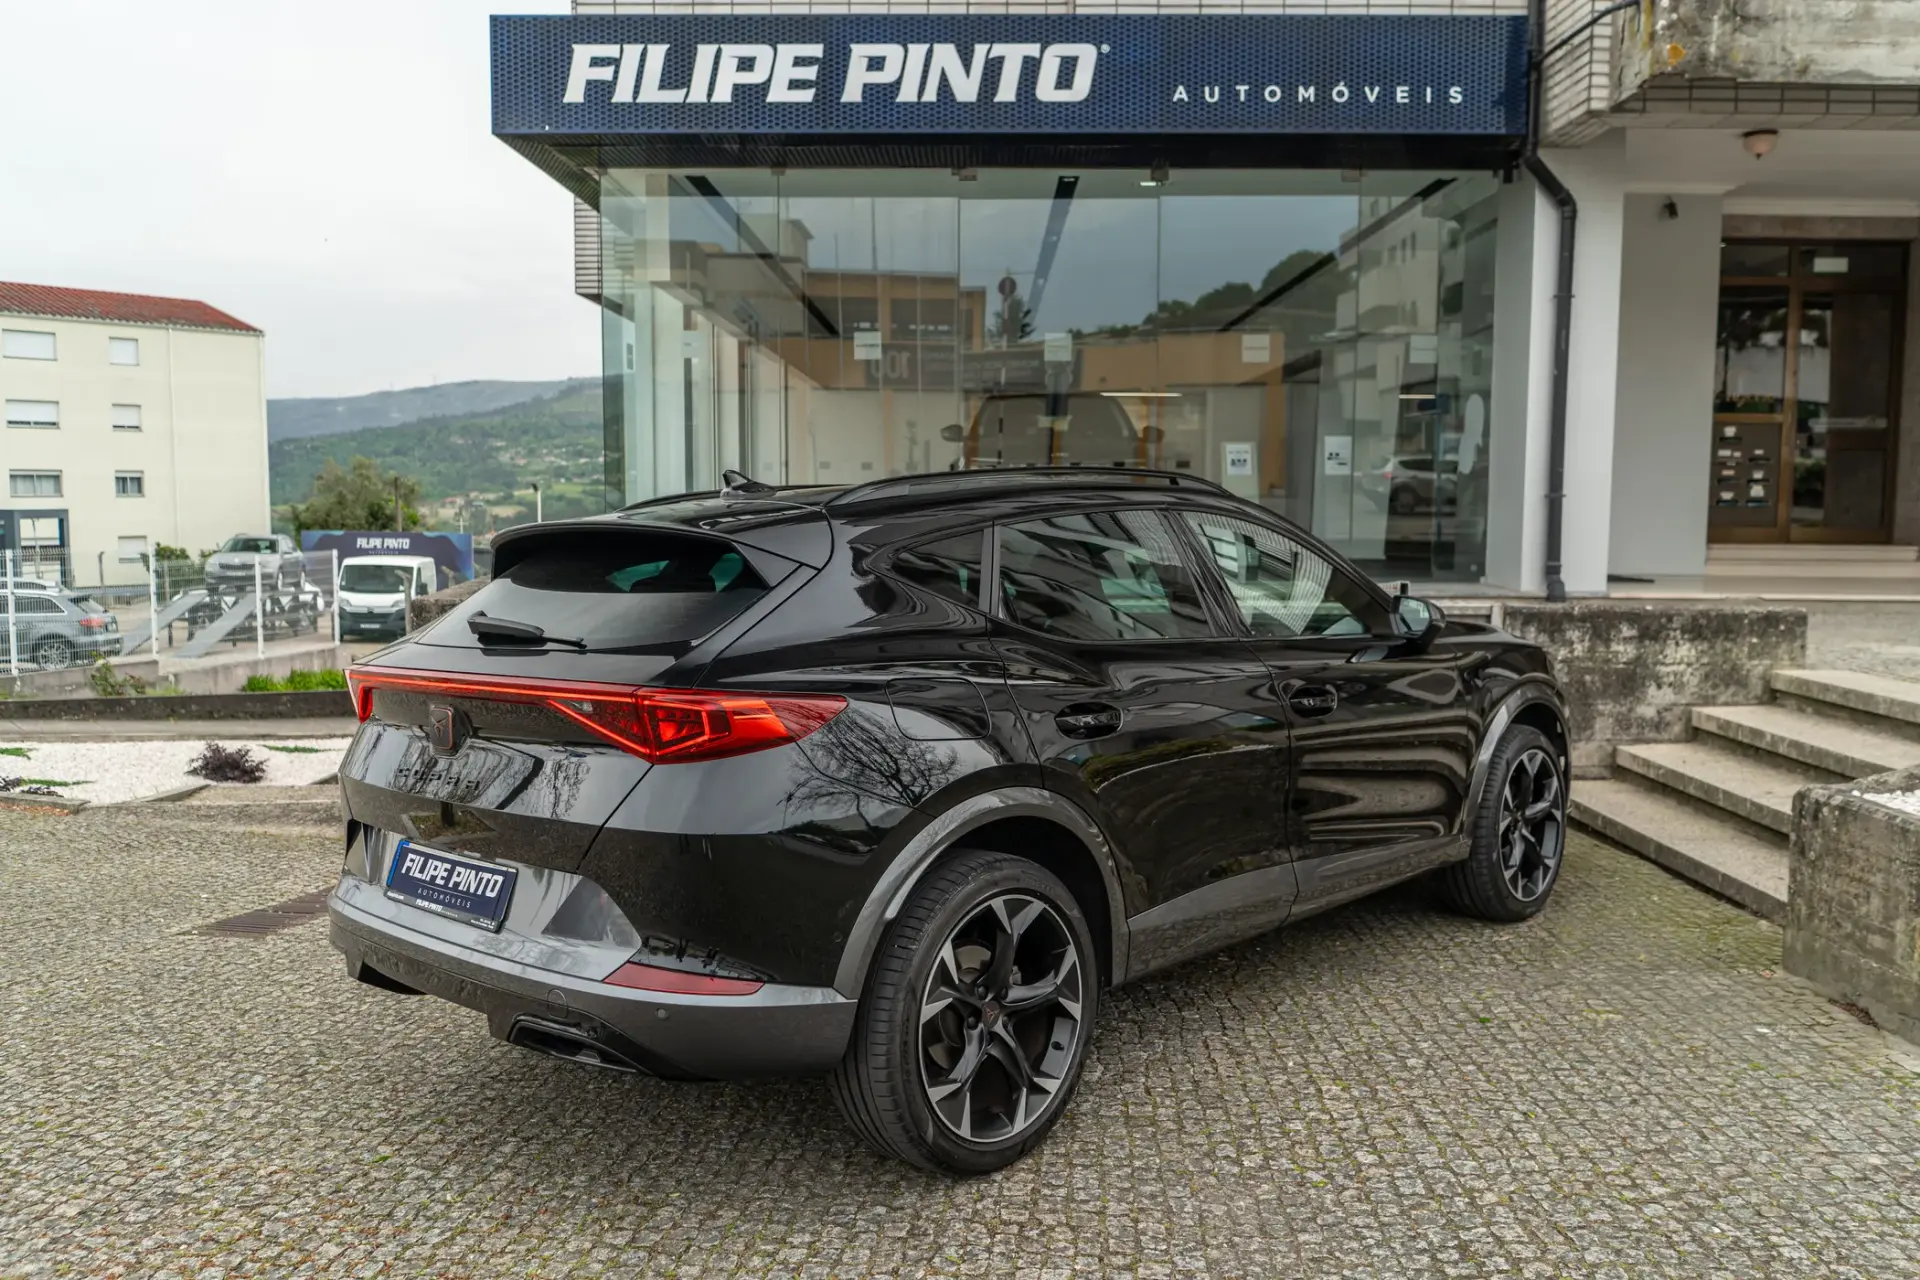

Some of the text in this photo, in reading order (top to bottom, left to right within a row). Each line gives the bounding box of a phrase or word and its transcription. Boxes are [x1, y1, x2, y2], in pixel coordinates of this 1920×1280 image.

[562, 43, 824, 104] FILIPE
[1172, 81, 1463, 104] AUTOMÓVEIS
[356, 537, 410, 550] FILIPE PINTO
[401, 853, 504, 898] FILIPE PINTO
[417, 887, 472, 909] AUTOMÓVEIS
